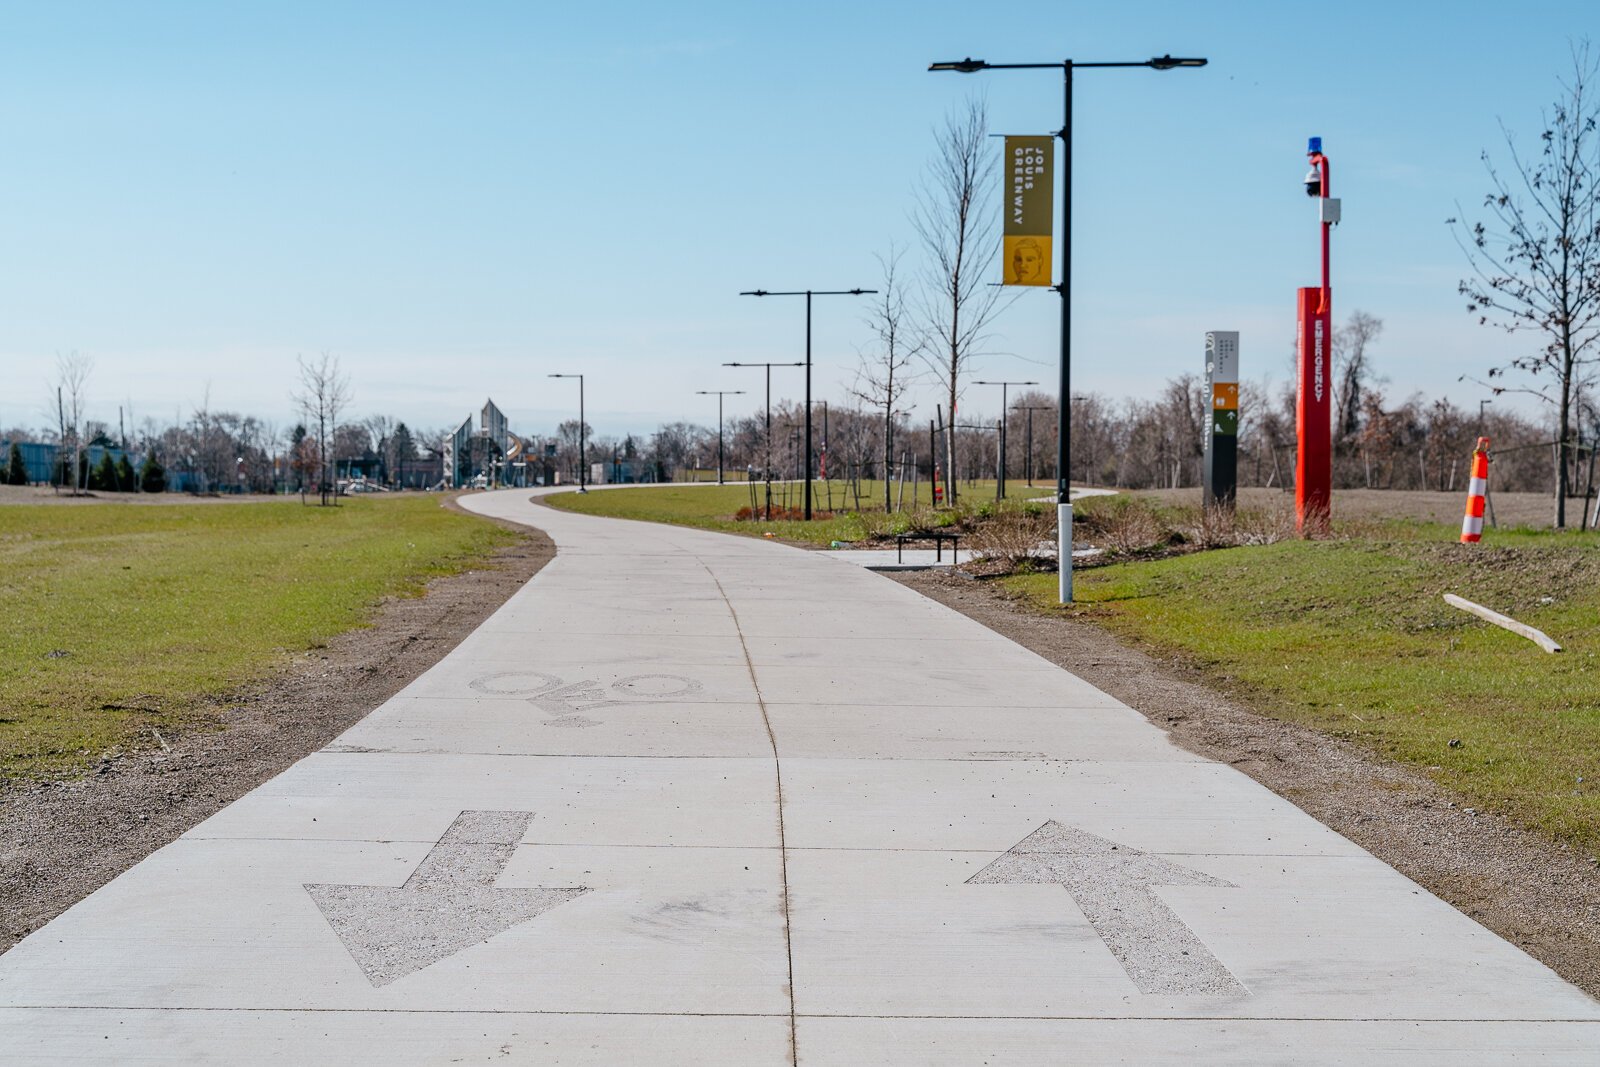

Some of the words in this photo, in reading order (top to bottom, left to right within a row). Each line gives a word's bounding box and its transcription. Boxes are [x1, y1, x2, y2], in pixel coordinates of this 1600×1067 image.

[1014, 148, 1023, 224] GREENWAY
[1025, 148, 1033, 190] LOUIS
[1036, 148, 1044, 174] JOE
[1314, 320, 1323, 402] EMERGENCY
